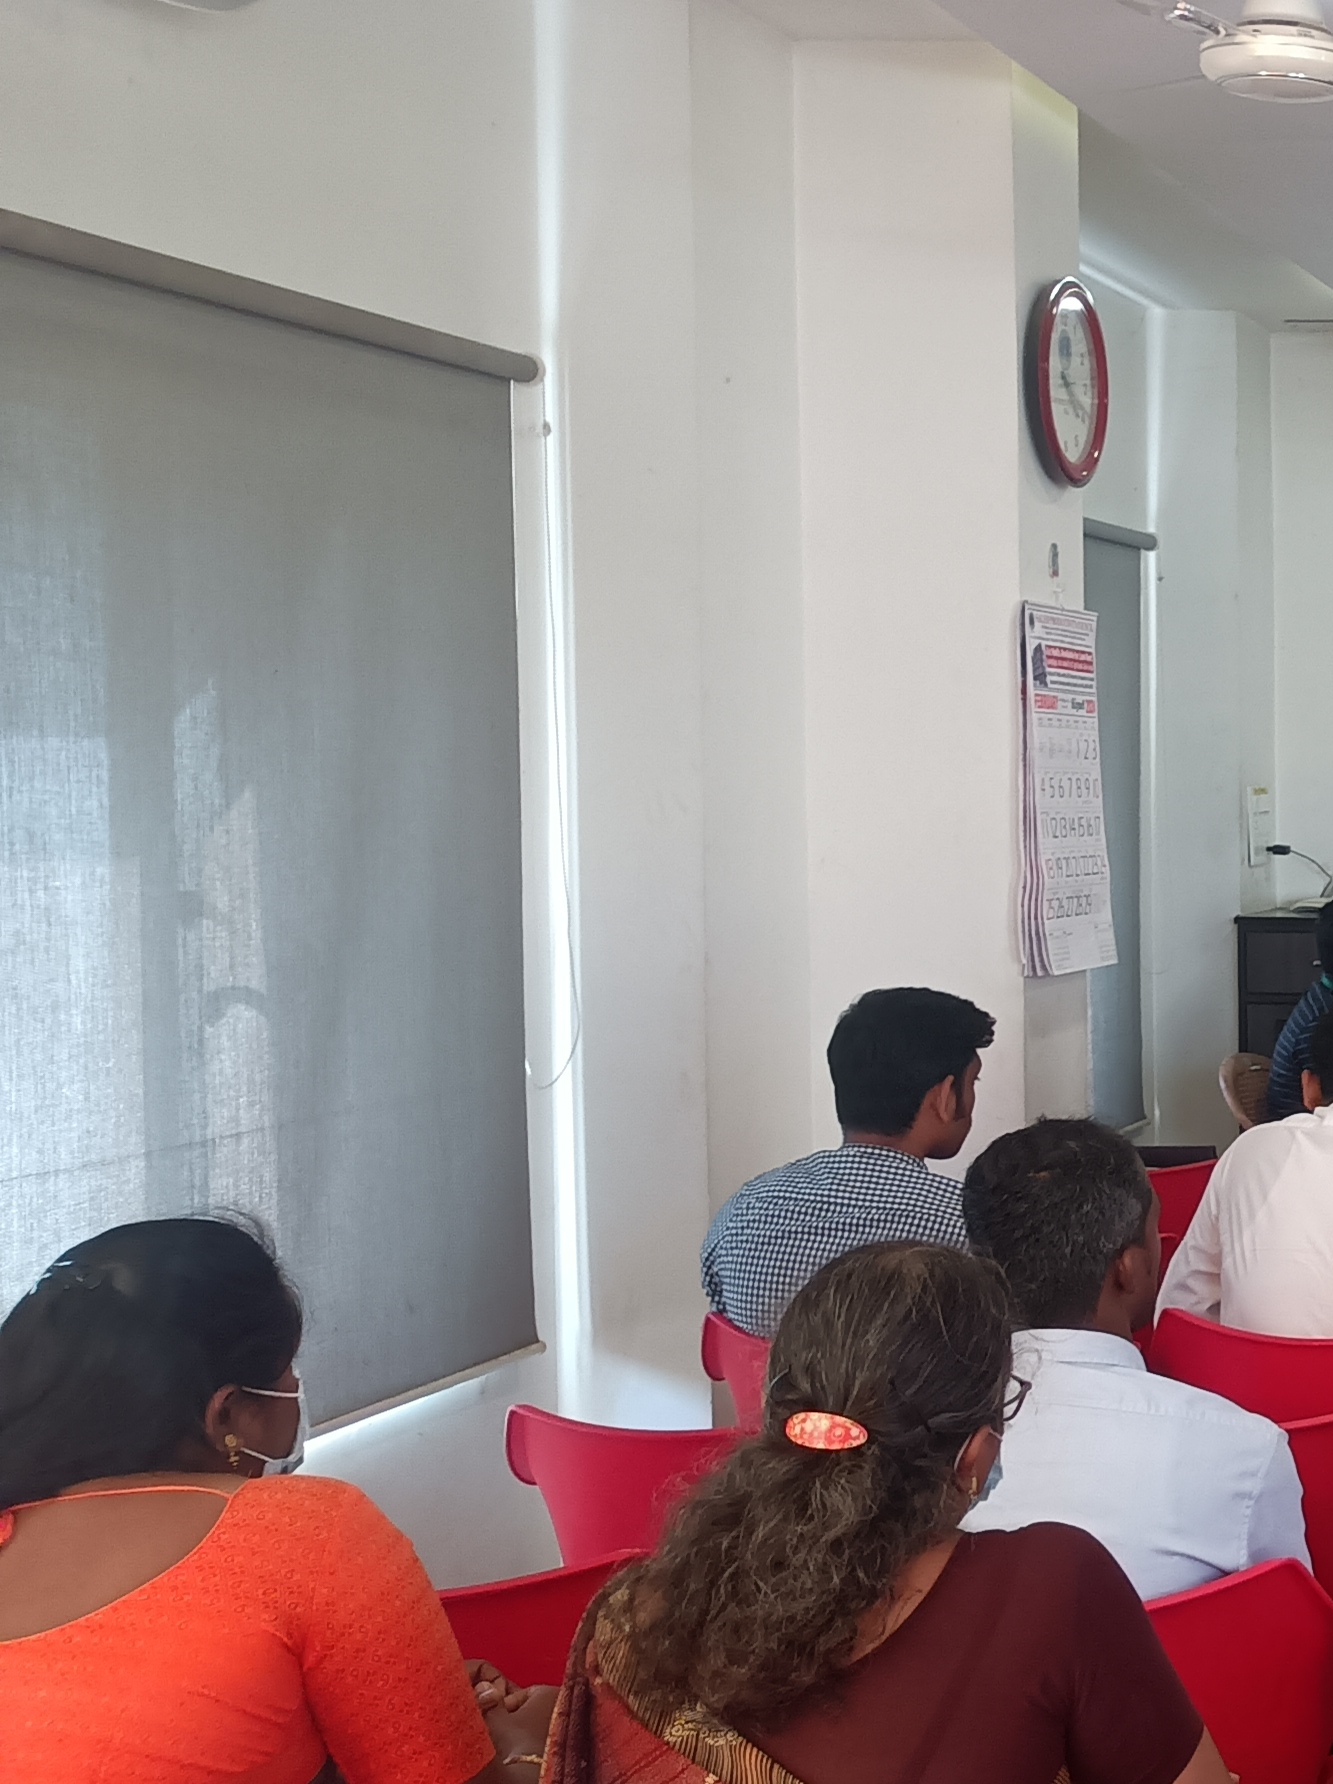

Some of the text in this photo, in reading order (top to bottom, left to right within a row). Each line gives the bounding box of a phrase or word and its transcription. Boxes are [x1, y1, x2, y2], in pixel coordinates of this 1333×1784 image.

[1049, 777, 1055, 799] 5
[1058, 777, 1065, 799] 6
[1067, 777, 1073, 798] 7
